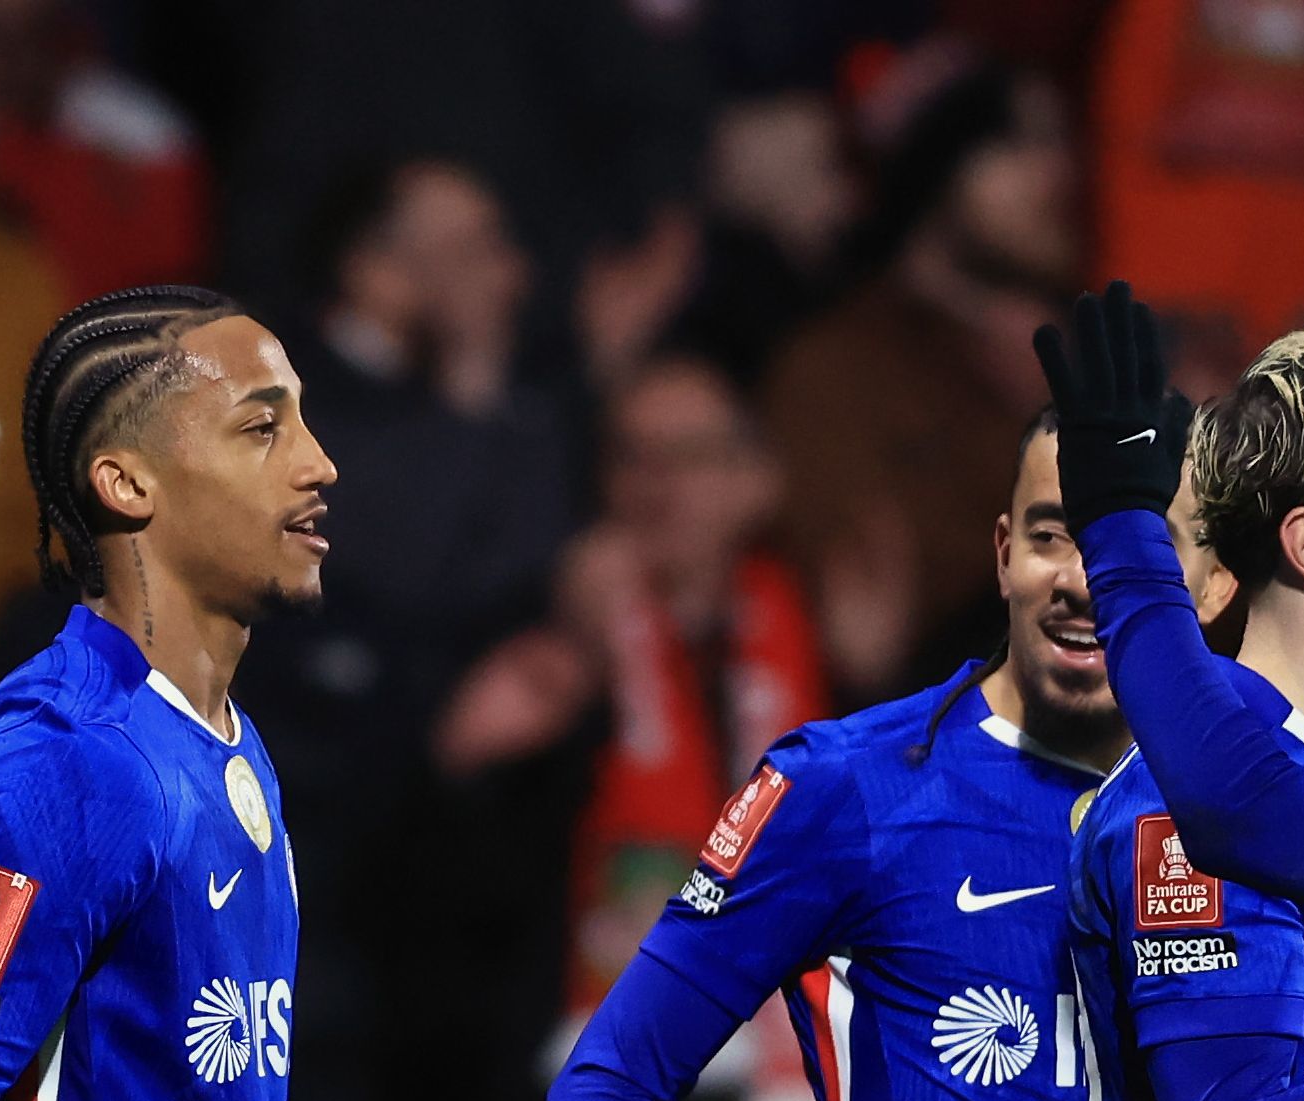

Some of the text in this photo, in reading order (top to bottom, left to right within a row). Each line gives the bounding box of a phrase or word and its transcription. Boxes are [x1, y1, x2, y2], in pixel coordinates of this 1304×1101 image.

[713, 838, 737, 859] CUP
[1147, 883, 1208, 898] Emirates
[1147, 898, 1209, 915] FA CUP
[1132, 937, 1225, 959] No room
[1163, 951, 1238, 974] racism
